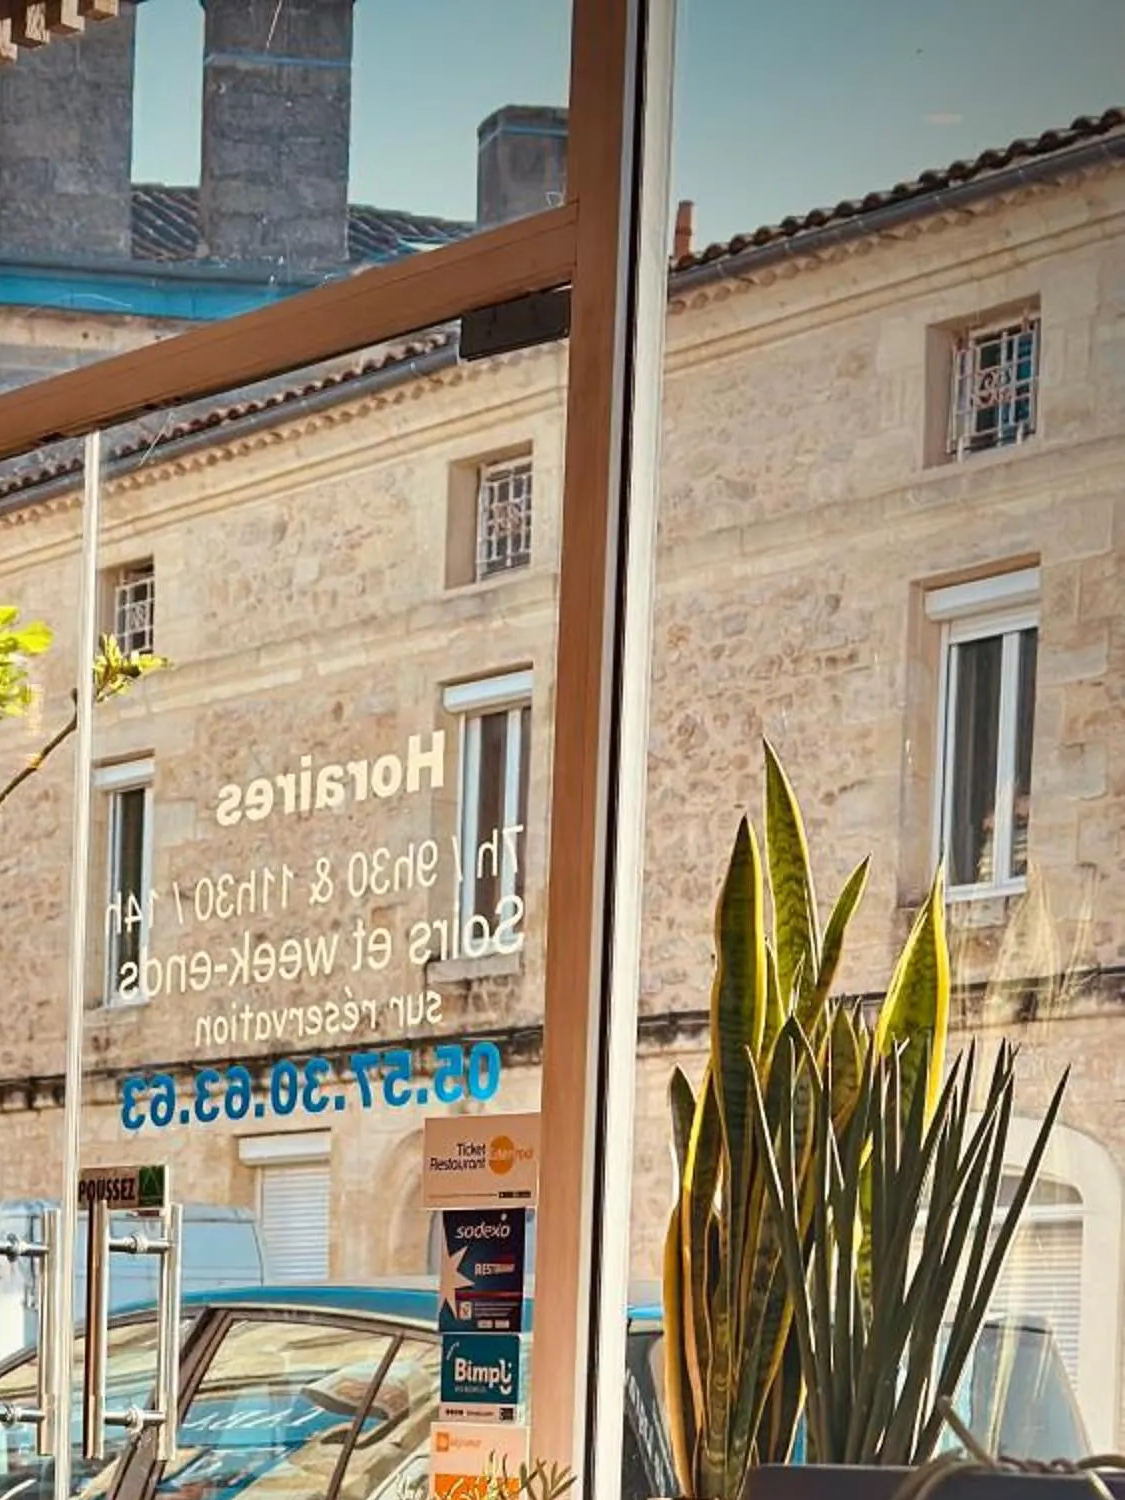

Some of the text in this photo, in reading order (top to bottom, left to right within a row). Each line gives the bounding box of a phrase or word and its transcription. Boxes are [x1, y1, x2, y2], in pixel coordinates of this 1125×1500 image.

[457, 1143, 486, 1157] Ticket
[78, 1178, 135, 1202] POUSSEZ
[455, 1221, 510, 1239] sodexo
